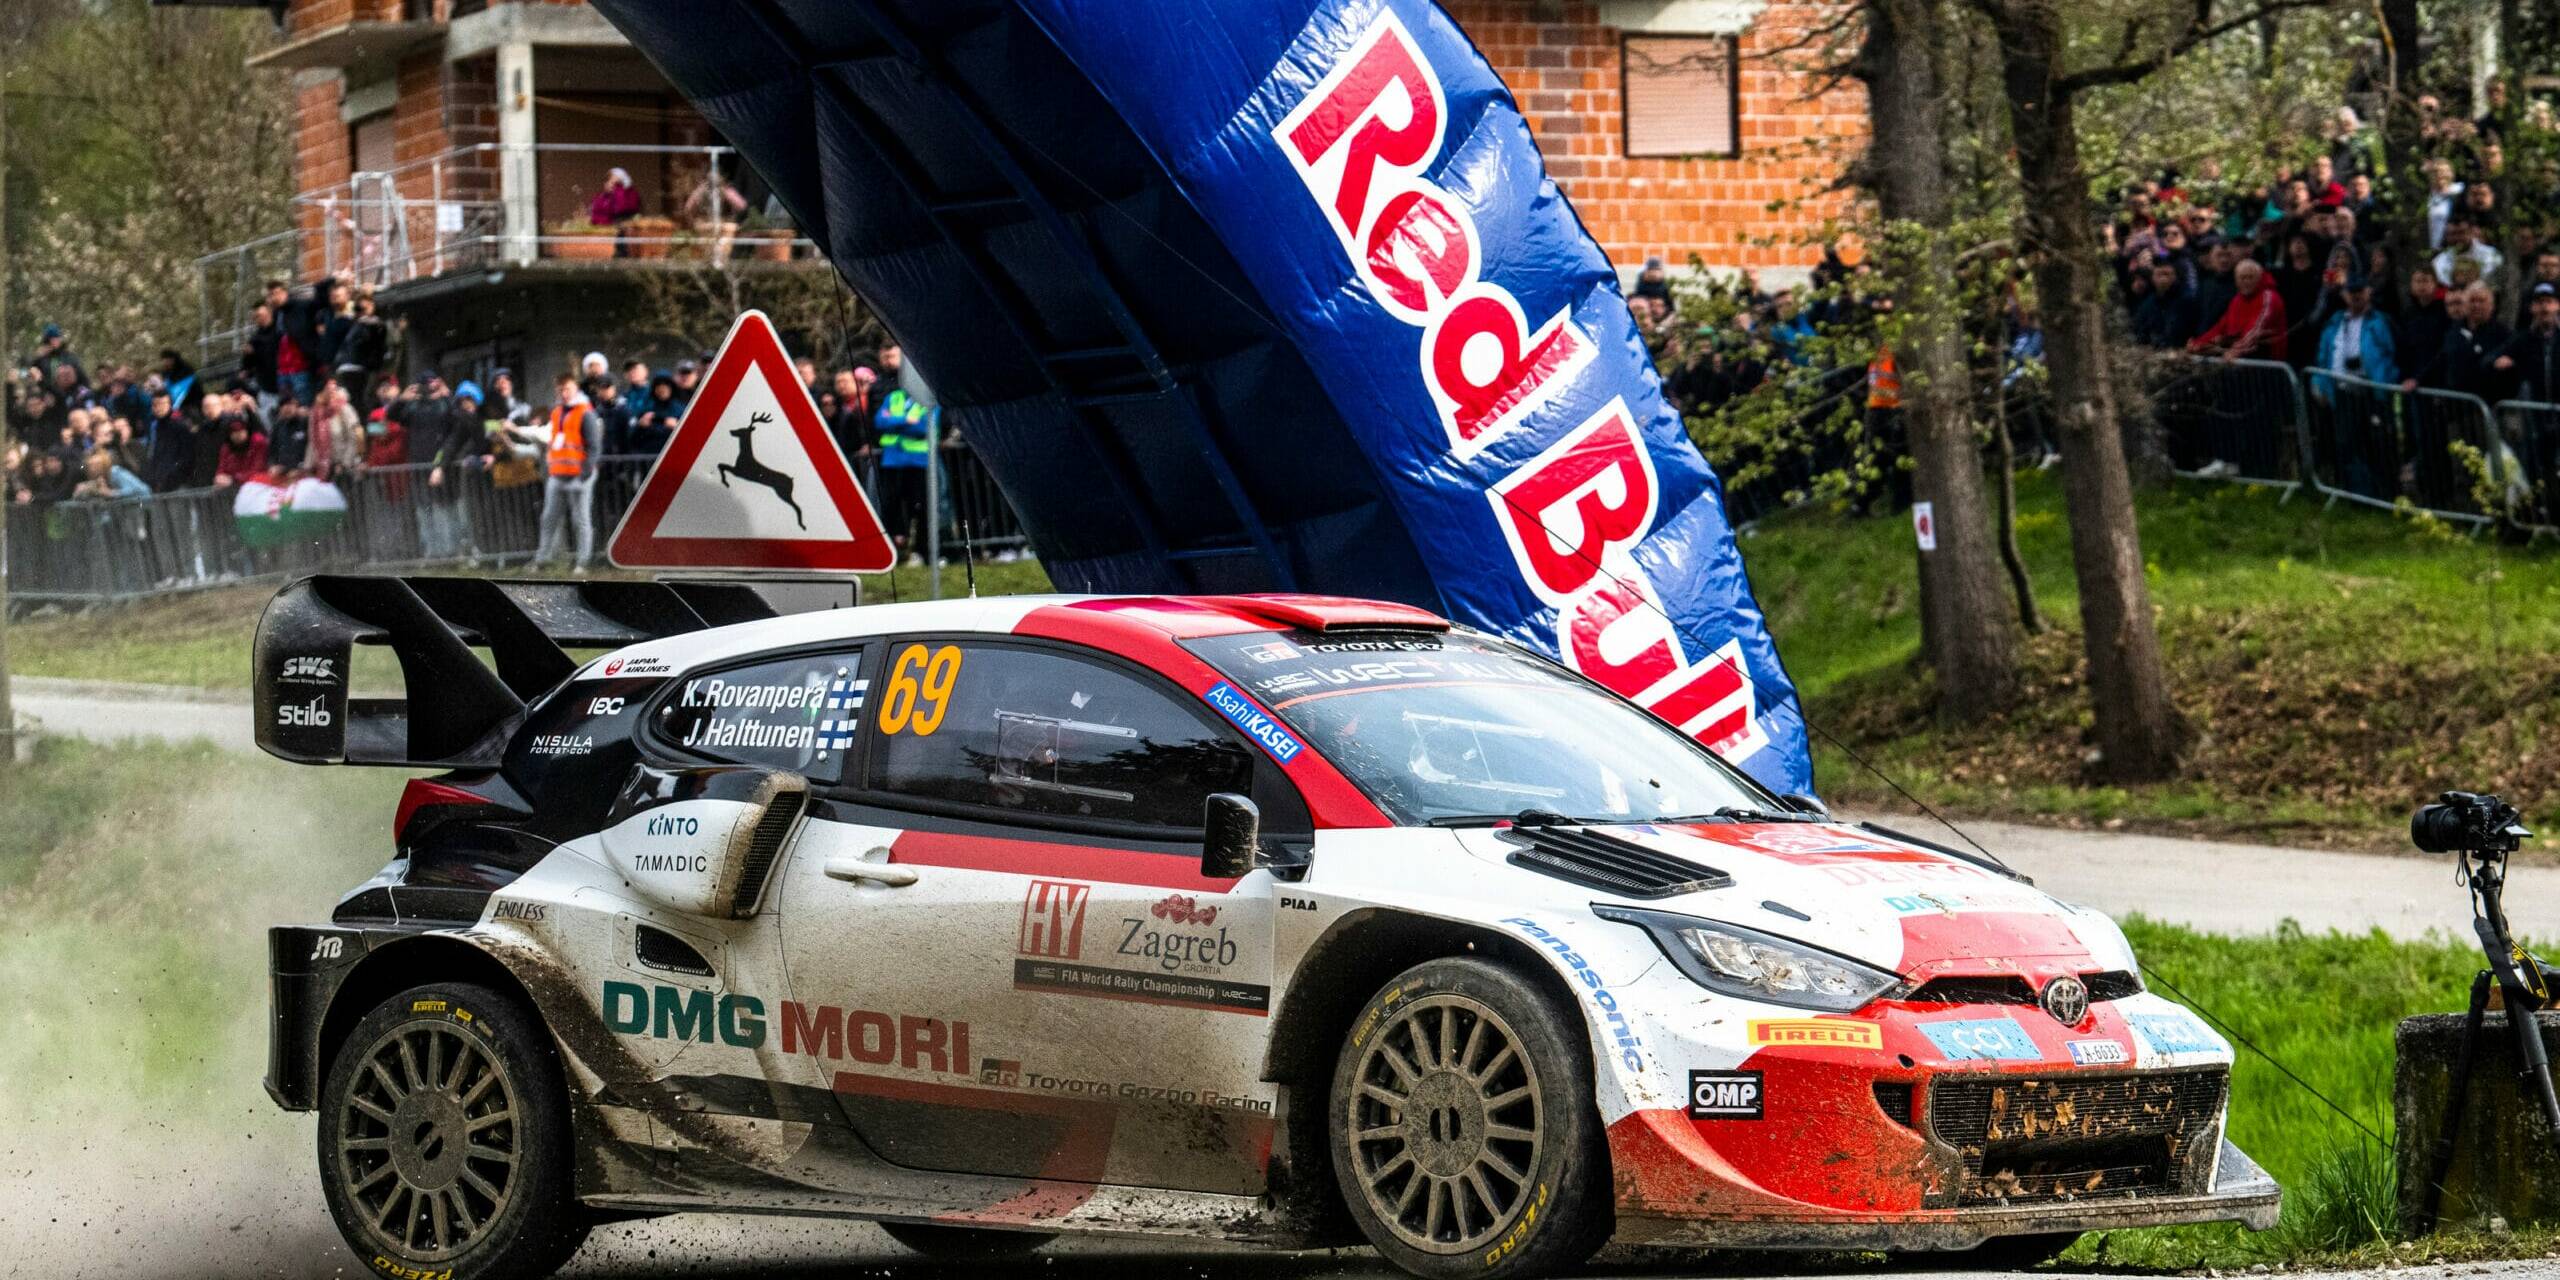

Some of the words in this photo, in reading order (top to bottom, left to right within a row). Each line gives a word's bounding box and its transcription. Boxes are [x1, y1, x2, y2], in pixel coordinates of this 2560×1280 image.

[1281, 14, 1590, 450] Red
[1496, 404, 1762, 760] Bull
[1299, 642, 1394, 654] TOYOTA
[282, 656, 338, 679] SWS
[624, 665, 671, 673] AIRLINES
[626, 658, 660, 666] JAPAN
[879, 643, 962, 736] 69
[278, 693, 331, 727] Stilo
[532, 735, 593, 747] NISULA
[683, 718, 814, 749] J.Halttunen
[635, 854, 707, 873] TAMADIC
[494, 900, 547, 921] ENDLESS
[1280, 896, 1318, 912] PIAA
[310, 935, 344, 961] JTB
[1116, 917, 1238, 971] Zagreb
[1183, 963, 1222, 976] CROATIA
[1061, 969, 1080, 984] FIA
[1081, 971, 1112, 987] World
[1114, 976, 1141, 992] Rally
[1142, 978, 1216, 998] Championship
[1499, 917, 1645, 1074] Panasonic
[602, 980, 767, 1050] DMG
[780, 1000, 971, 1076] MORI
[1756, 1023, 1872, 1045] PIRELLI
[1025, 1073, 1112, 1097] TOYOTA
[1202, 1089, 1272, 1118] Racing
[1695, 1083, 1757, 1107] OMP
